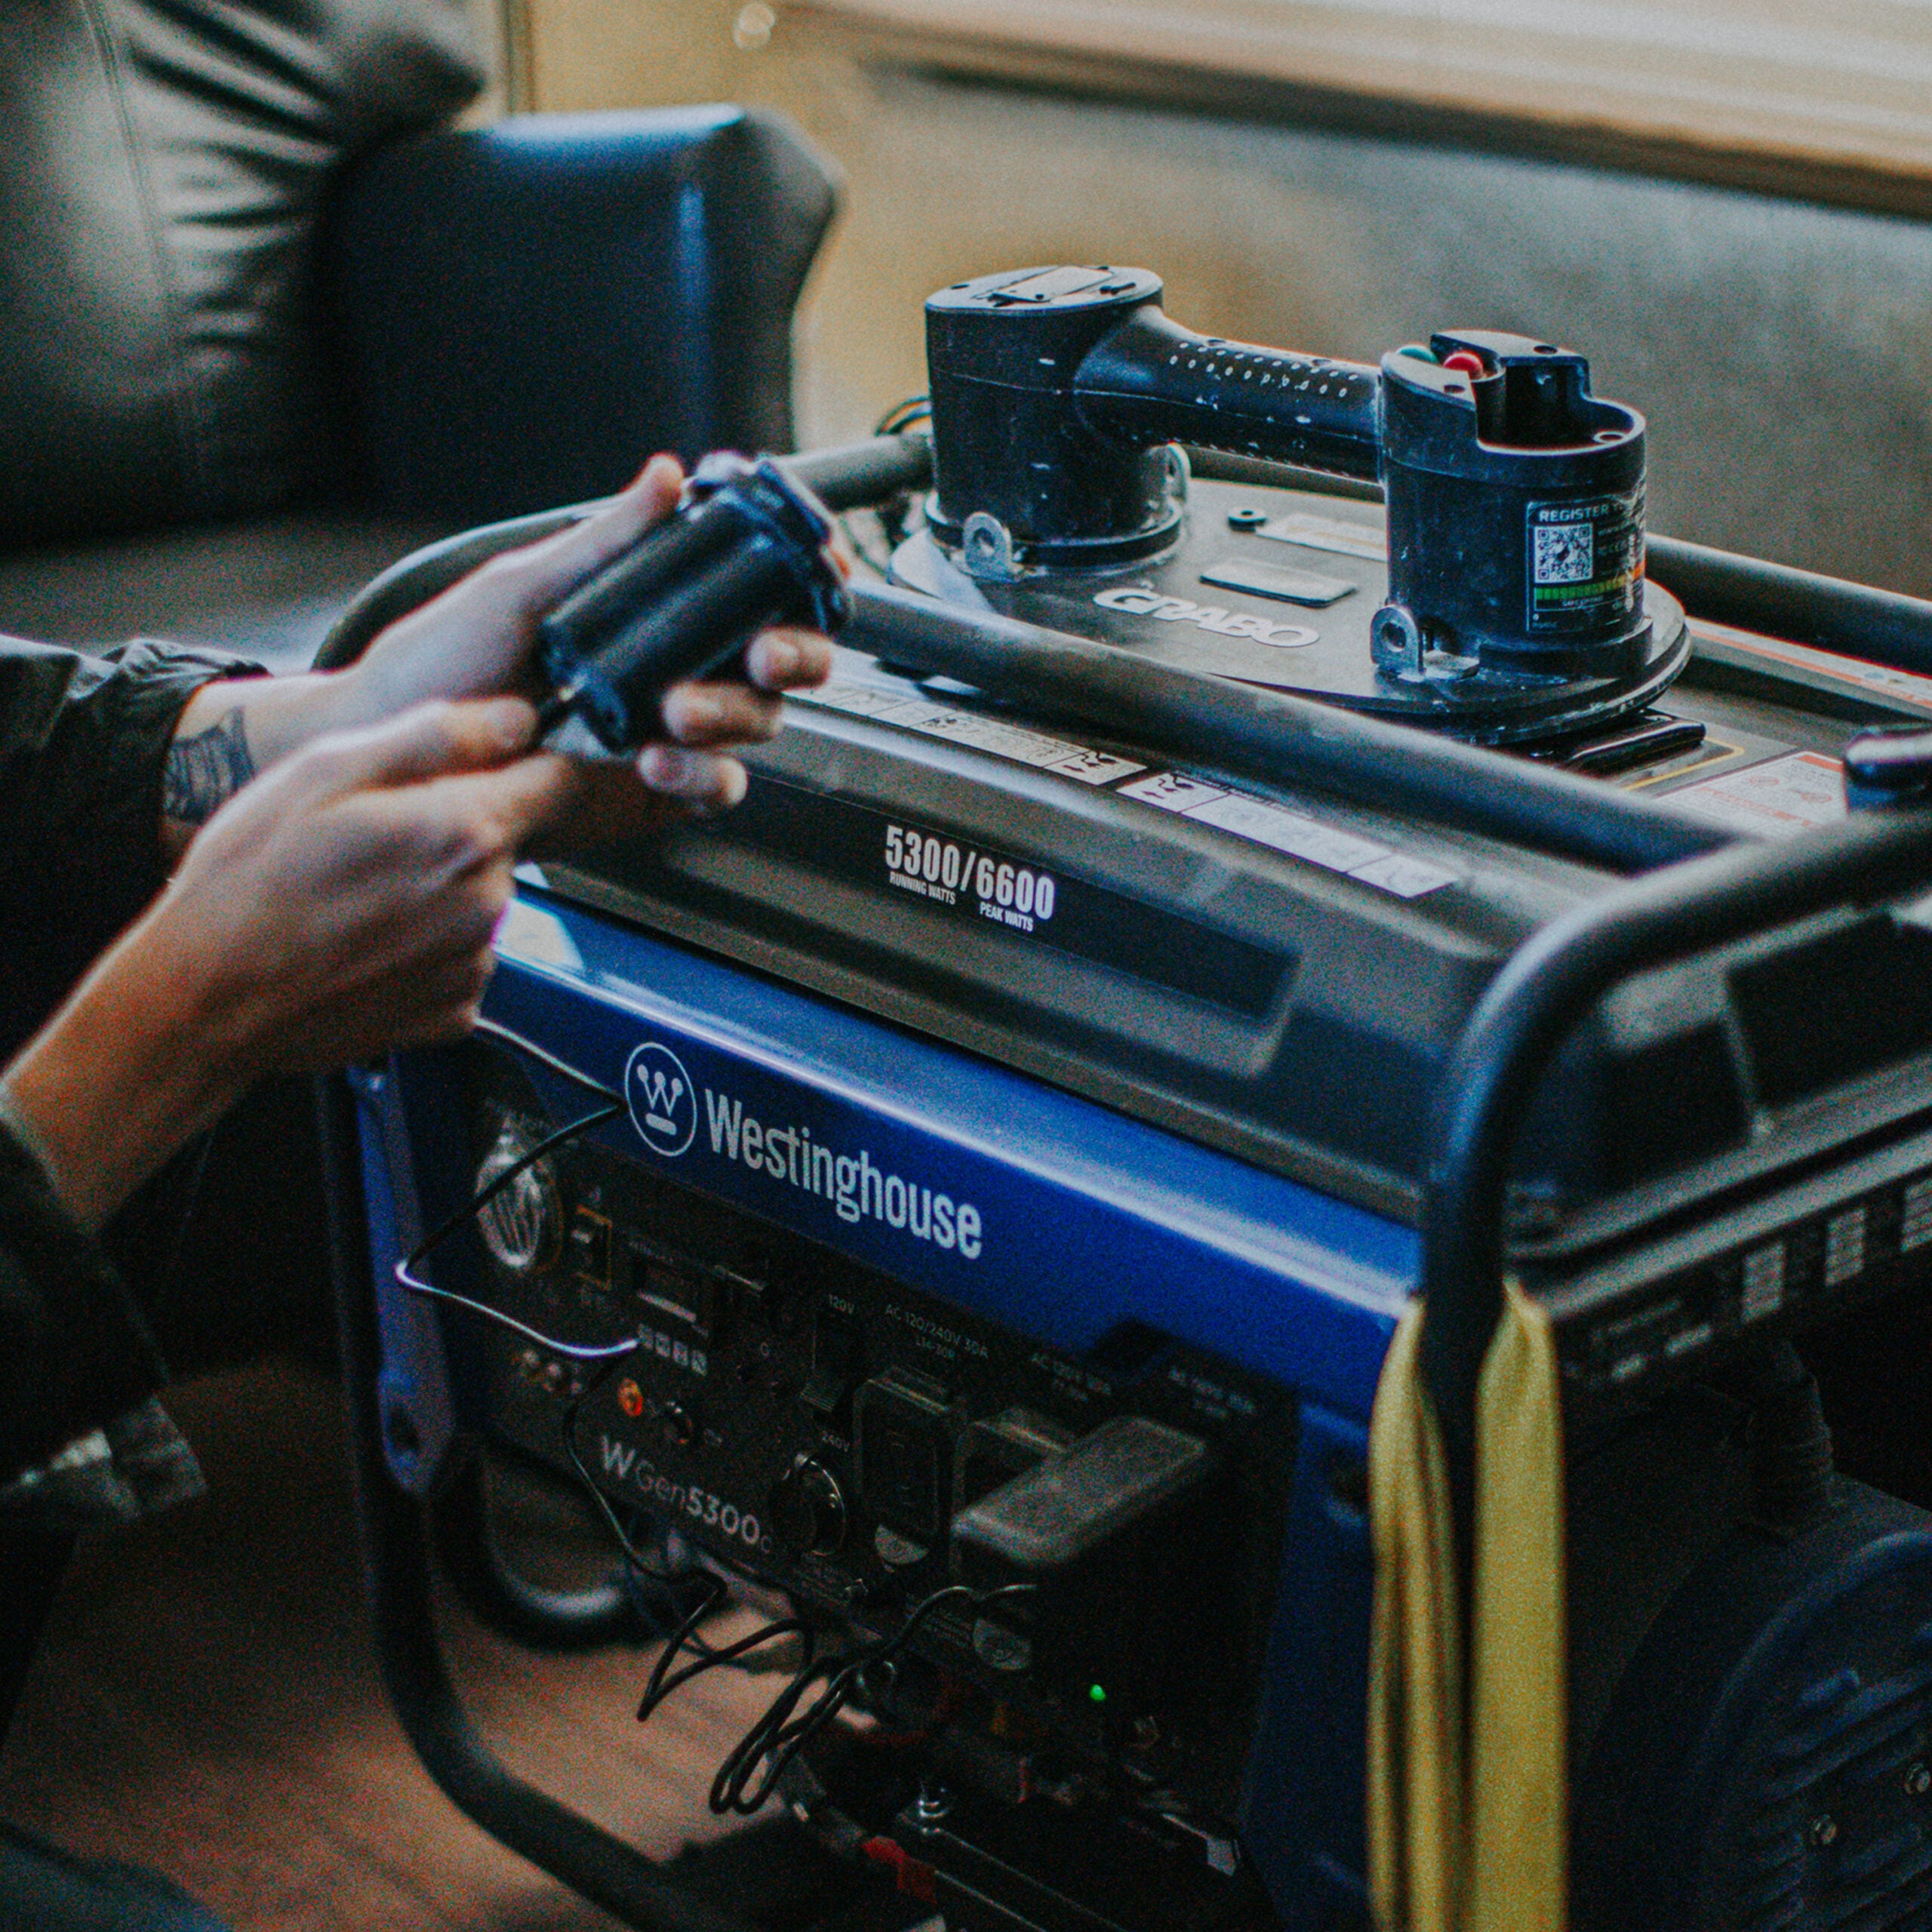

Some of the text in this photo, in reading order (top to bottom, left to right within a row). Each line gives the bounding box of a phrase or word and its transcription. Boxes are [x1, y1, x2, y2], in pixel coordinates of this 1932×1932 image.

[1539, 503, 1609, 522] REGISTER
[1094, 586, 1320, 648] GRABO
[885, 825, 1055, 920] 5300/6600
[889, 871, 956, 905] RUNNING WATTS
[980, 901, 1034, 932] PEAK WATTS
[705, 1088, 982, 1260] Westinghouse
